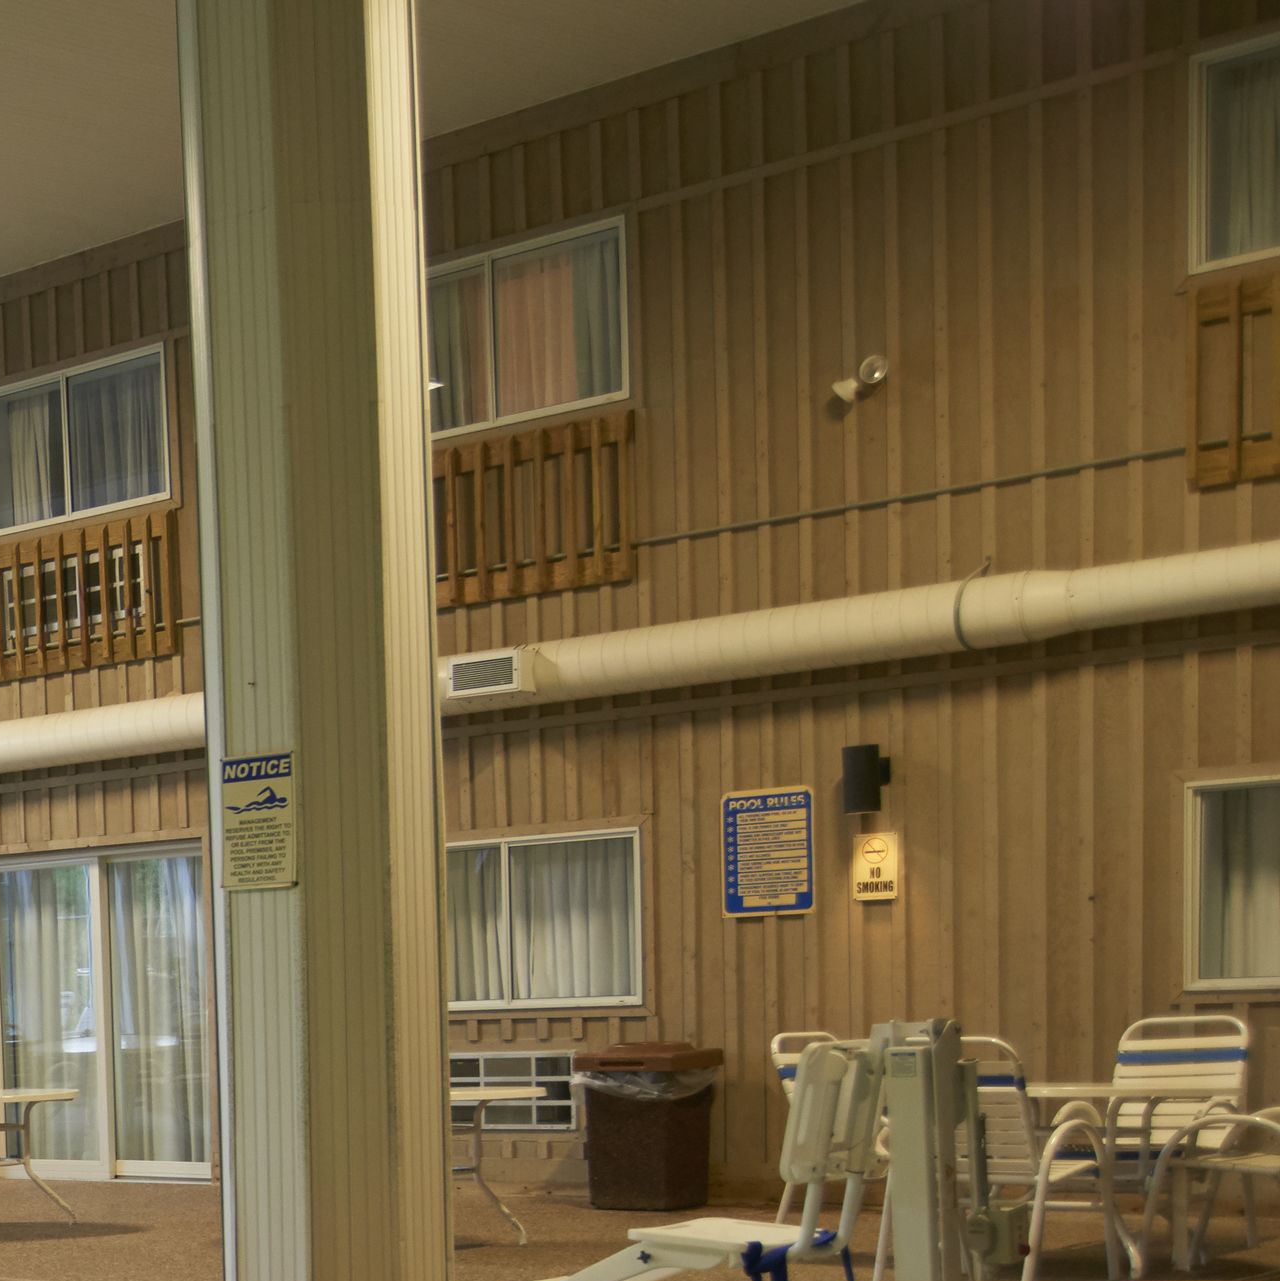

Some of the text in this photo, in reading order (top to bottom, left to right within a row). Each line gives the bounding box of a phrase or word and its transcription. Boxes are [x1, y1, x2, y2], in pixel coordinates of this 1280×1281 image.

[224, 759, 290, 780] NOTICE
[729, 795, 805, 811] POOL RULES
[869, 866, 881, 879] NO
[856, 880, 894, 894] SMOKING
